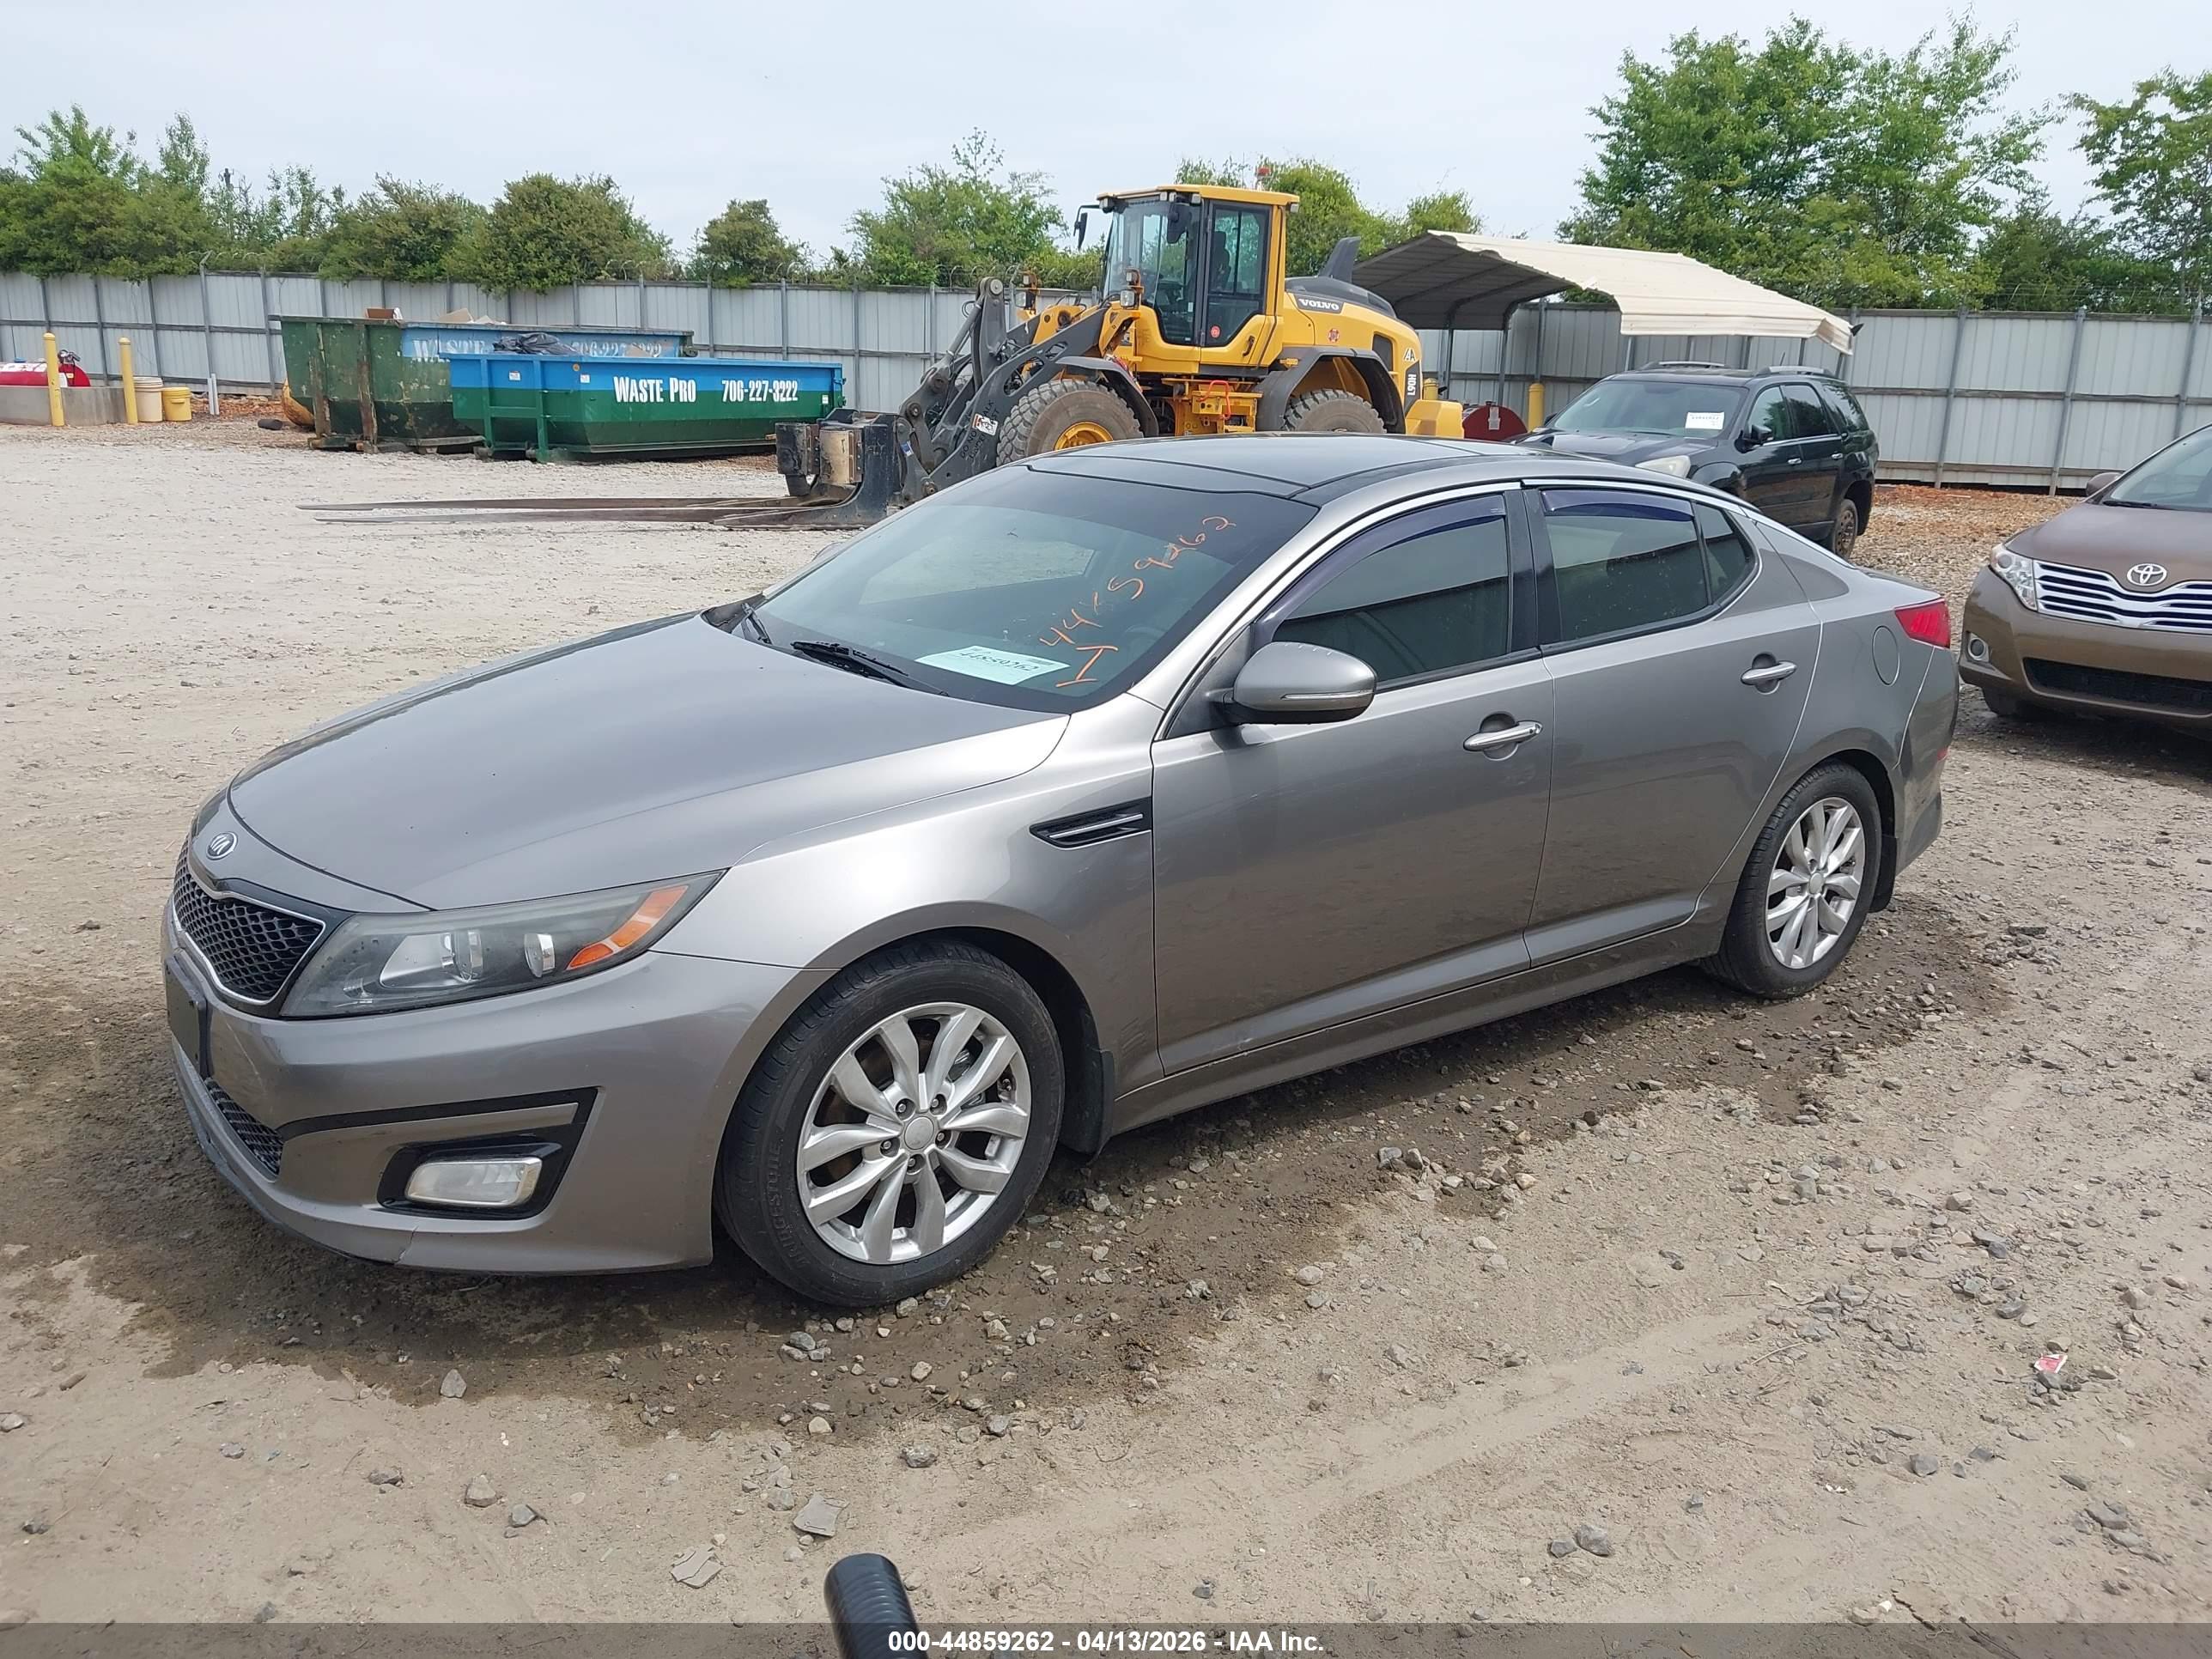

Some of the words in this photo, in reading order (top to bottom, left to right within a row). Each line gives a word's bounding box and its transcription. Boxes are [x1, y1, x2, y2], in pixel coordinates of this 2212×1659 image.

[1298, 298, 1340, 311] VOLVO
[613, 376, 664, 403] WASTE
[669, 377, 696, 403] PRO
[721, 380, 799, 403] 706-227-3222
[1407, 374, 1417, 396] L90H
